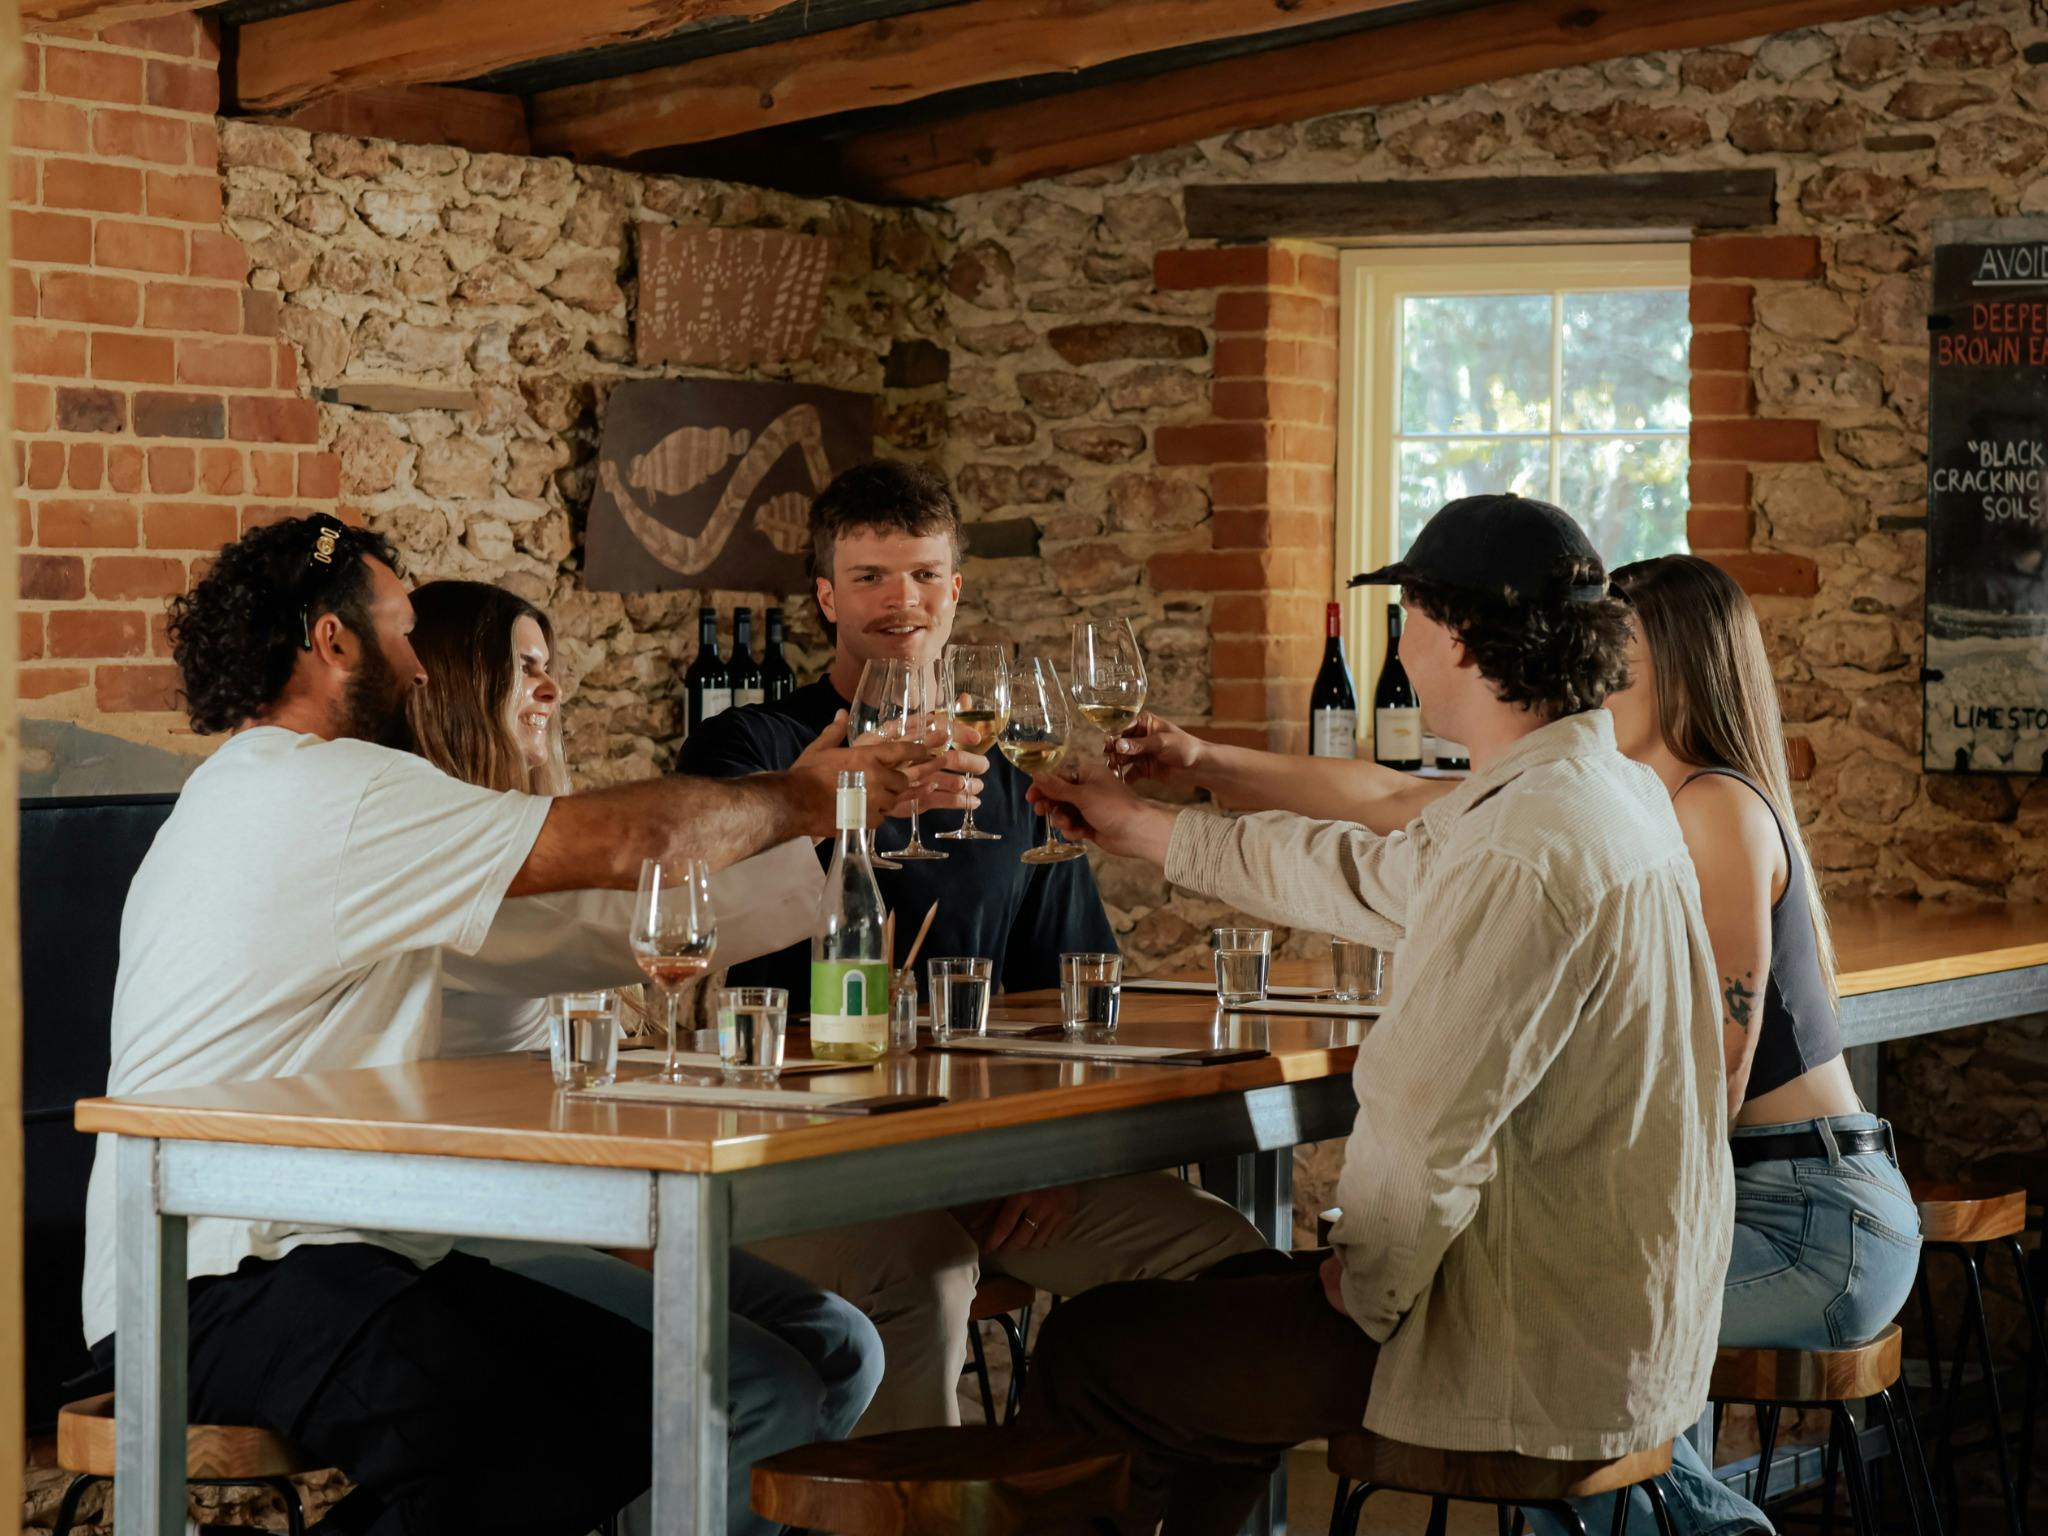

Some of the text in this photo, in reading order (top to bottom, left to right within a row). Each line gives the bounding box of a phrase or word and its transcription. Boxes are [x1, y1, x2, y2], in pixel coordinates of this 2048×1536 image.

[1972, 303, 2048, 334] DEEPE
[1938, 335, 2020, 366] BROWN
[1933, 468, 2040, 494] CRACKING
[1981, 496, 2042, 526] SOILS
